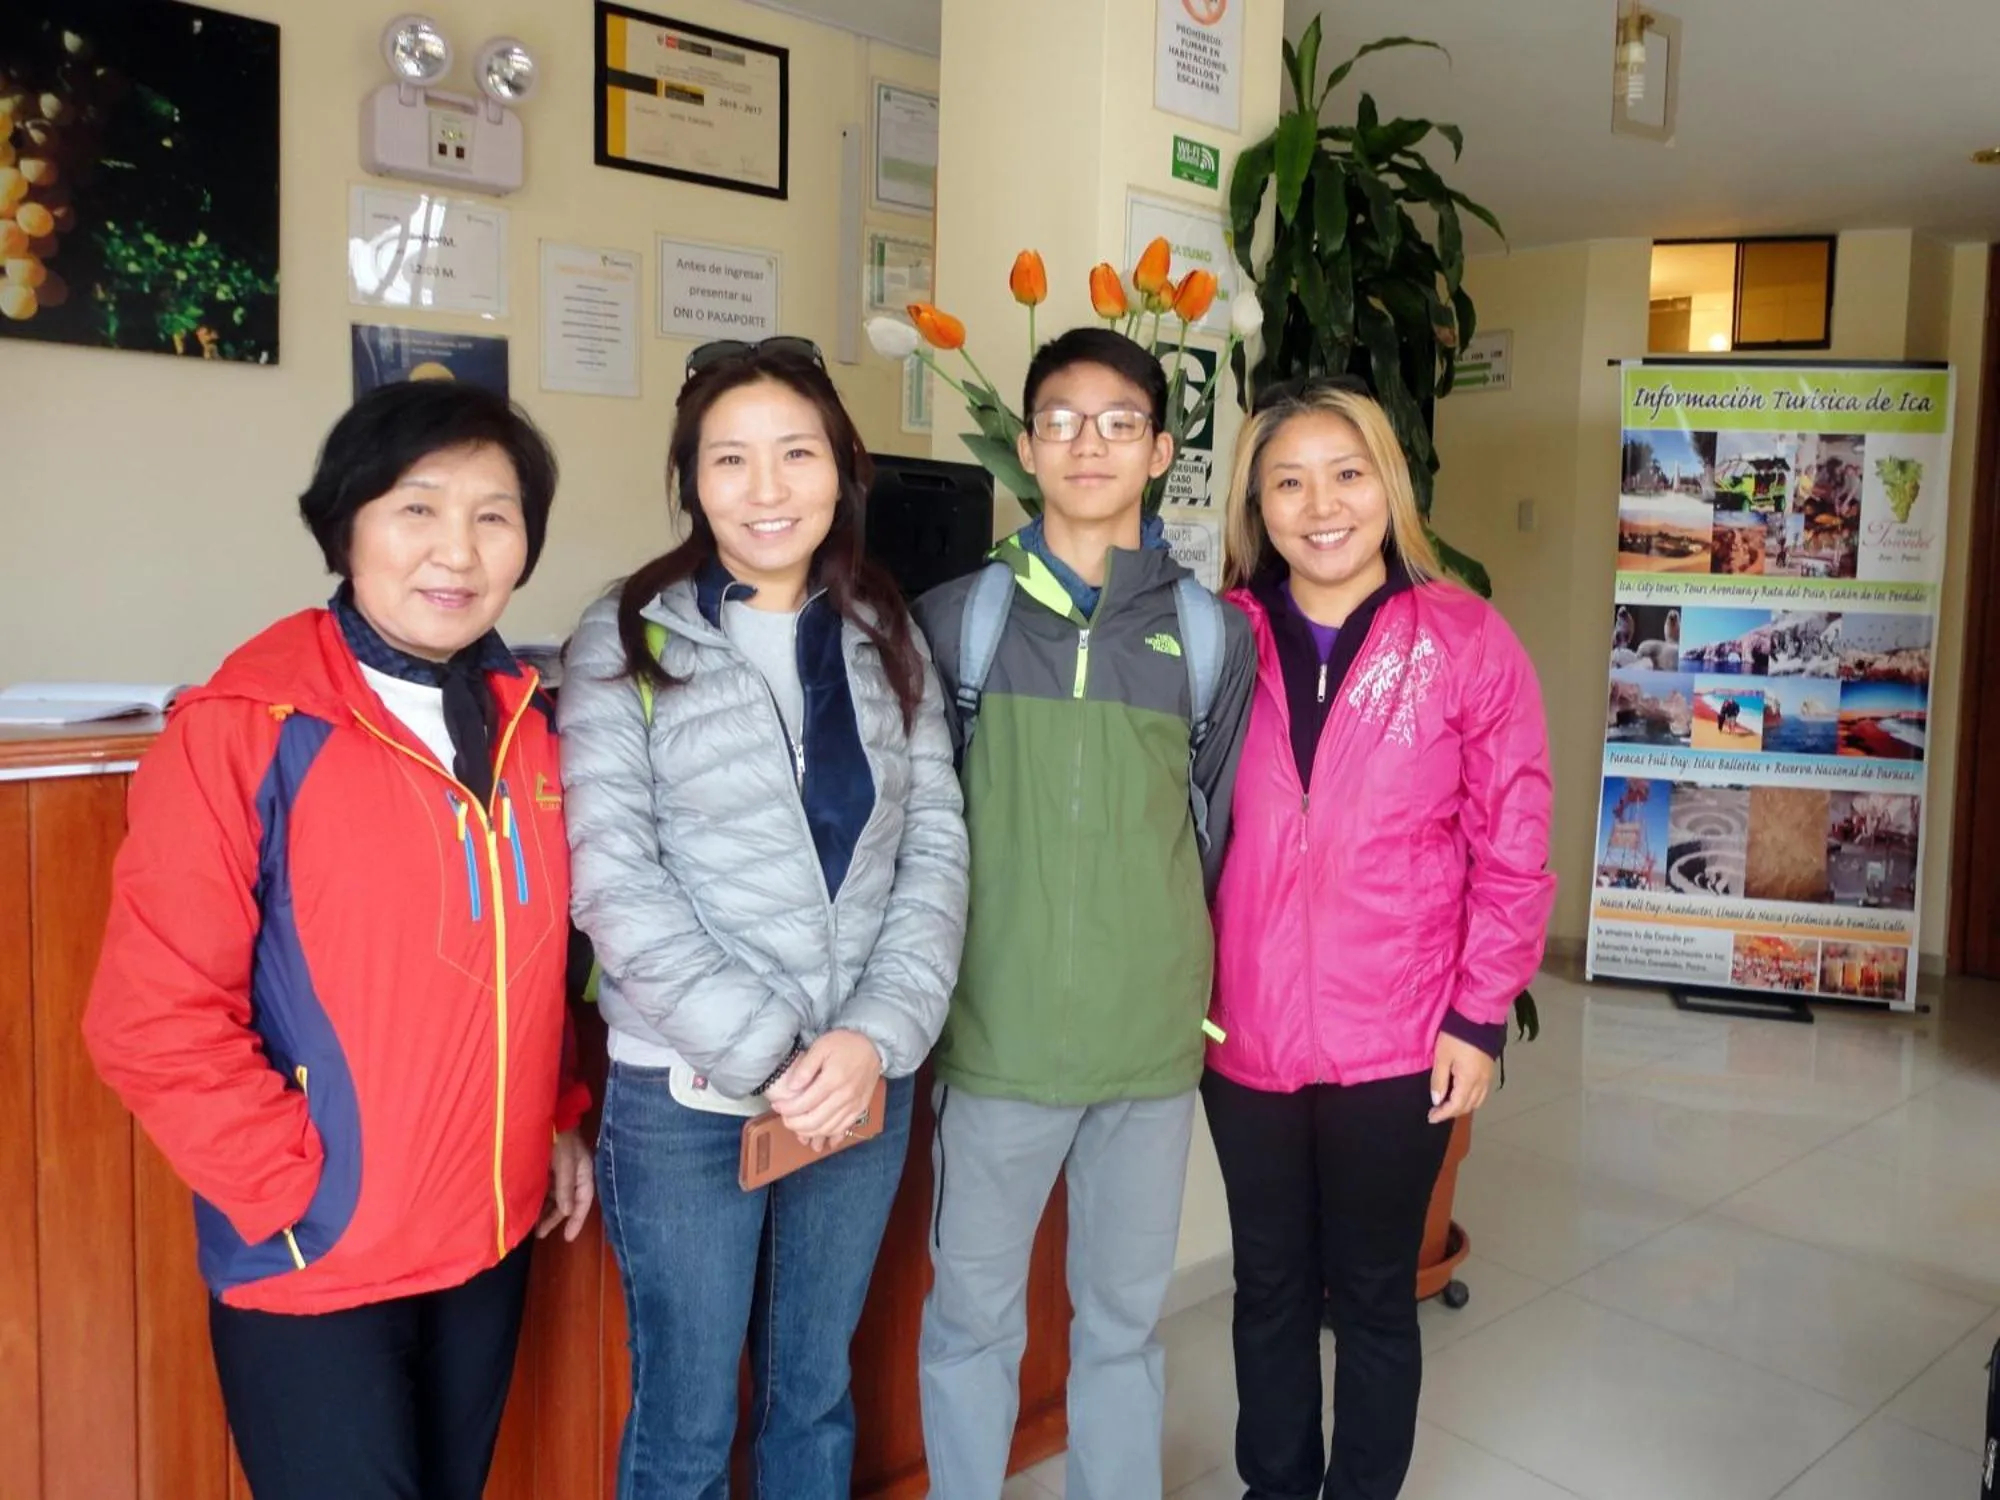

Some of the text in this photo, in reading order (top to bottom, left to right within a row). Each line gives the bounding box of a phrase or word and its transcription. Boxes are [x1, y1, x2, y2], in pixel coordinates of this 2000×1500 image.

[1181, 38, 1220, 58] FUMAR EN
[1176, 61, 1214, 80] PASILLOS
[1176, 72, 1220, 94] ESCALERAS
[676, 258, 764, 280] Antes de ingresar
[689, 286, 752, 303] presentar su
[673, 306, 766, 328] DNI O PASAPORTE
[1632, 384, 1763, 419] Información
[1865, 387, 1892, 411] de
[1899, 391, 1933, 412] Ica
[1170, 473, 1192, 485] CASO
[1786, 586, 1800, 598] del
[1860, 588, 1871, 600] de
[1609, 751, 1645, 766] Paracas
[1648, 753, 1667, 767] Full
[1693, 757, 1715, 769] Islas
[1718, 758, 1760, 773] Ballestas
[1774, 762, 1812, 774] Reserva
[1815, 763, 1859, 778] Nacional
[1861, 765, 1875, 779] de
[1876, 767, 1916, 781] Paracas
[1625, 898, 1643, 911] Full
[1745, 908, 1757, 920] de
[1833, 913, 1844, 927] de
